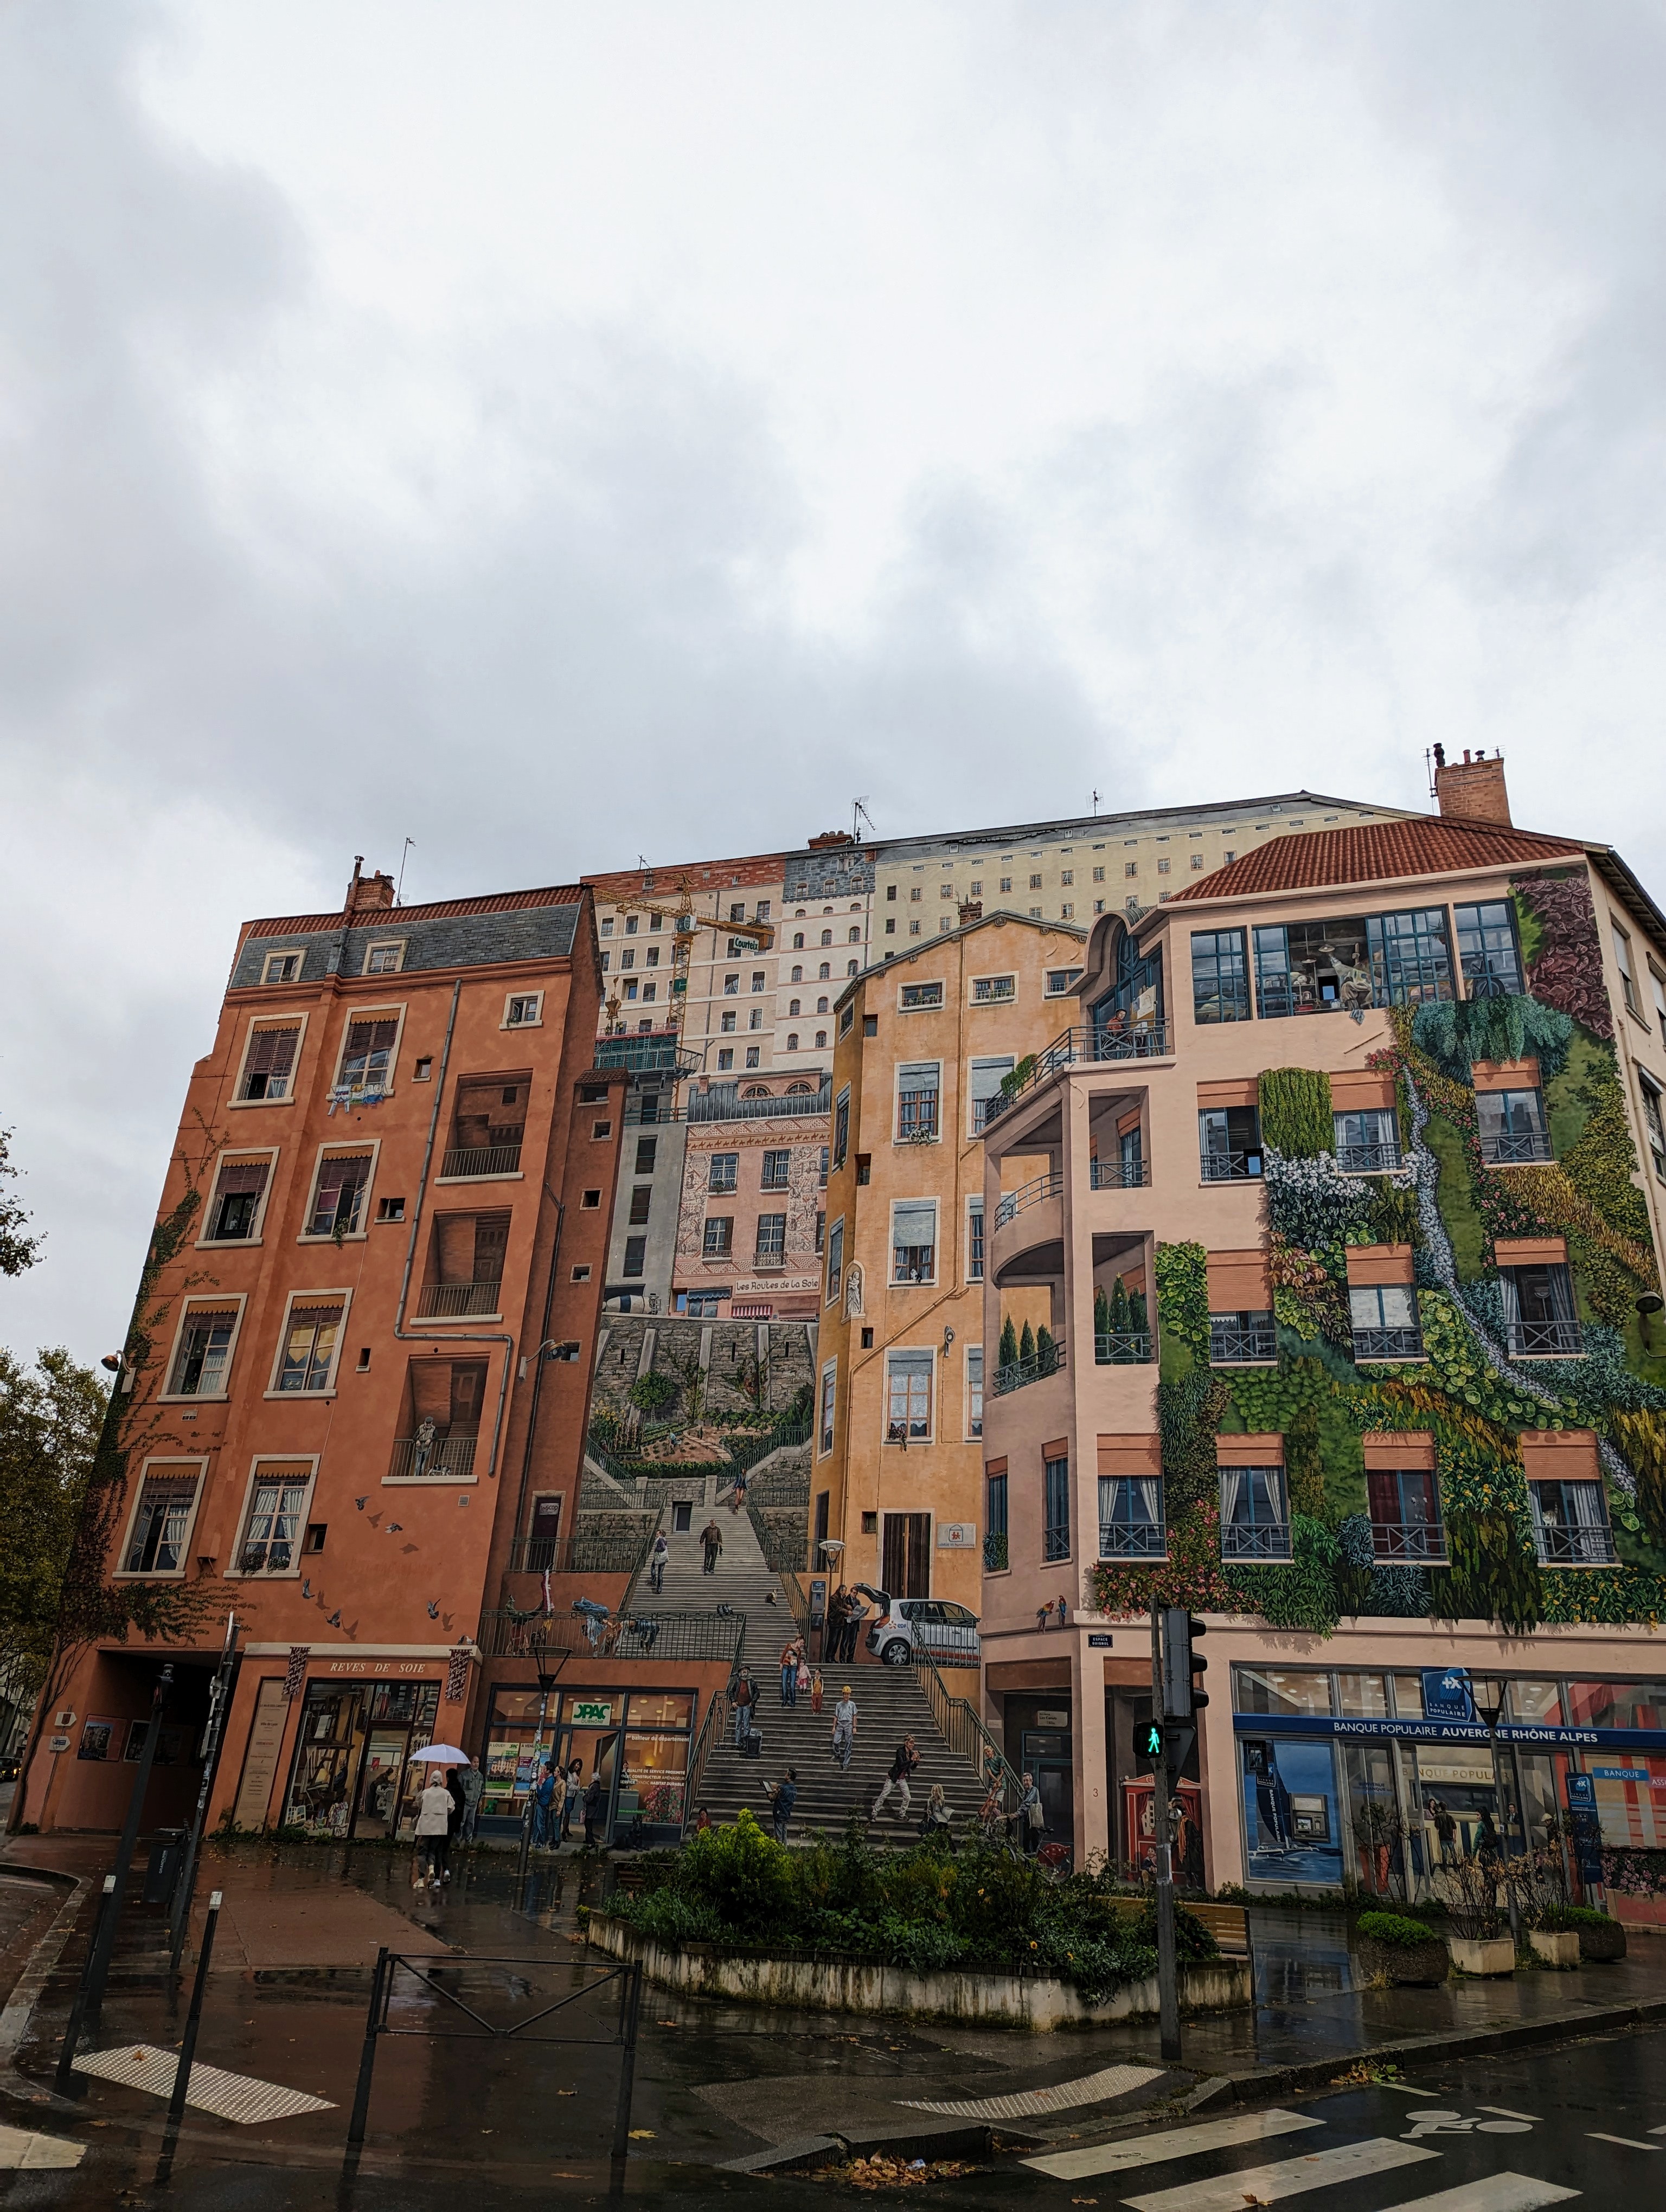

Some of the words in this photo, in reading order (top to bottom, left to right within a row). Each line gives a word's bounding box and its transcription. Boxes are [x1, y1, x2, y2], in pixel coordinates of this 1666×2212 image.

[735, 937, 758, 951] Courteix
[736, 1282, 749, 1290] Les
[751, 1281, 779, 1290] Routes
[780, 1280, 790, 1289] de
[802, 1278, 818, 1288] Soie
[330, 1662, 366, 1671] REVES
[374, 1663, 390, 1672] DE
[399, 1663, 426, 1673] SOIE
[1429, 1702, 1465, 1711] BANQUE
[1430, 1708, 1466, 1717] POPULAIRE
[1334, 1722, 1379, 1734] BANQUE
[1381, 1724, 1437, 1735] POPULAIRE
[1441, 1727, 1509, 1739] AUVERGNE
[1512, 1728, 1556, 1740] RHÔNE
[1559, 1732, 1598, 1742] ALPES
[1402, 1767, 1449, 1778] BNQUE
[1604, 1770, 1640, 1778] BANQUE
[1093, 1788, 1099, 1797] 3
[1273, 1812, 1281, 1843] POPULAIRE
